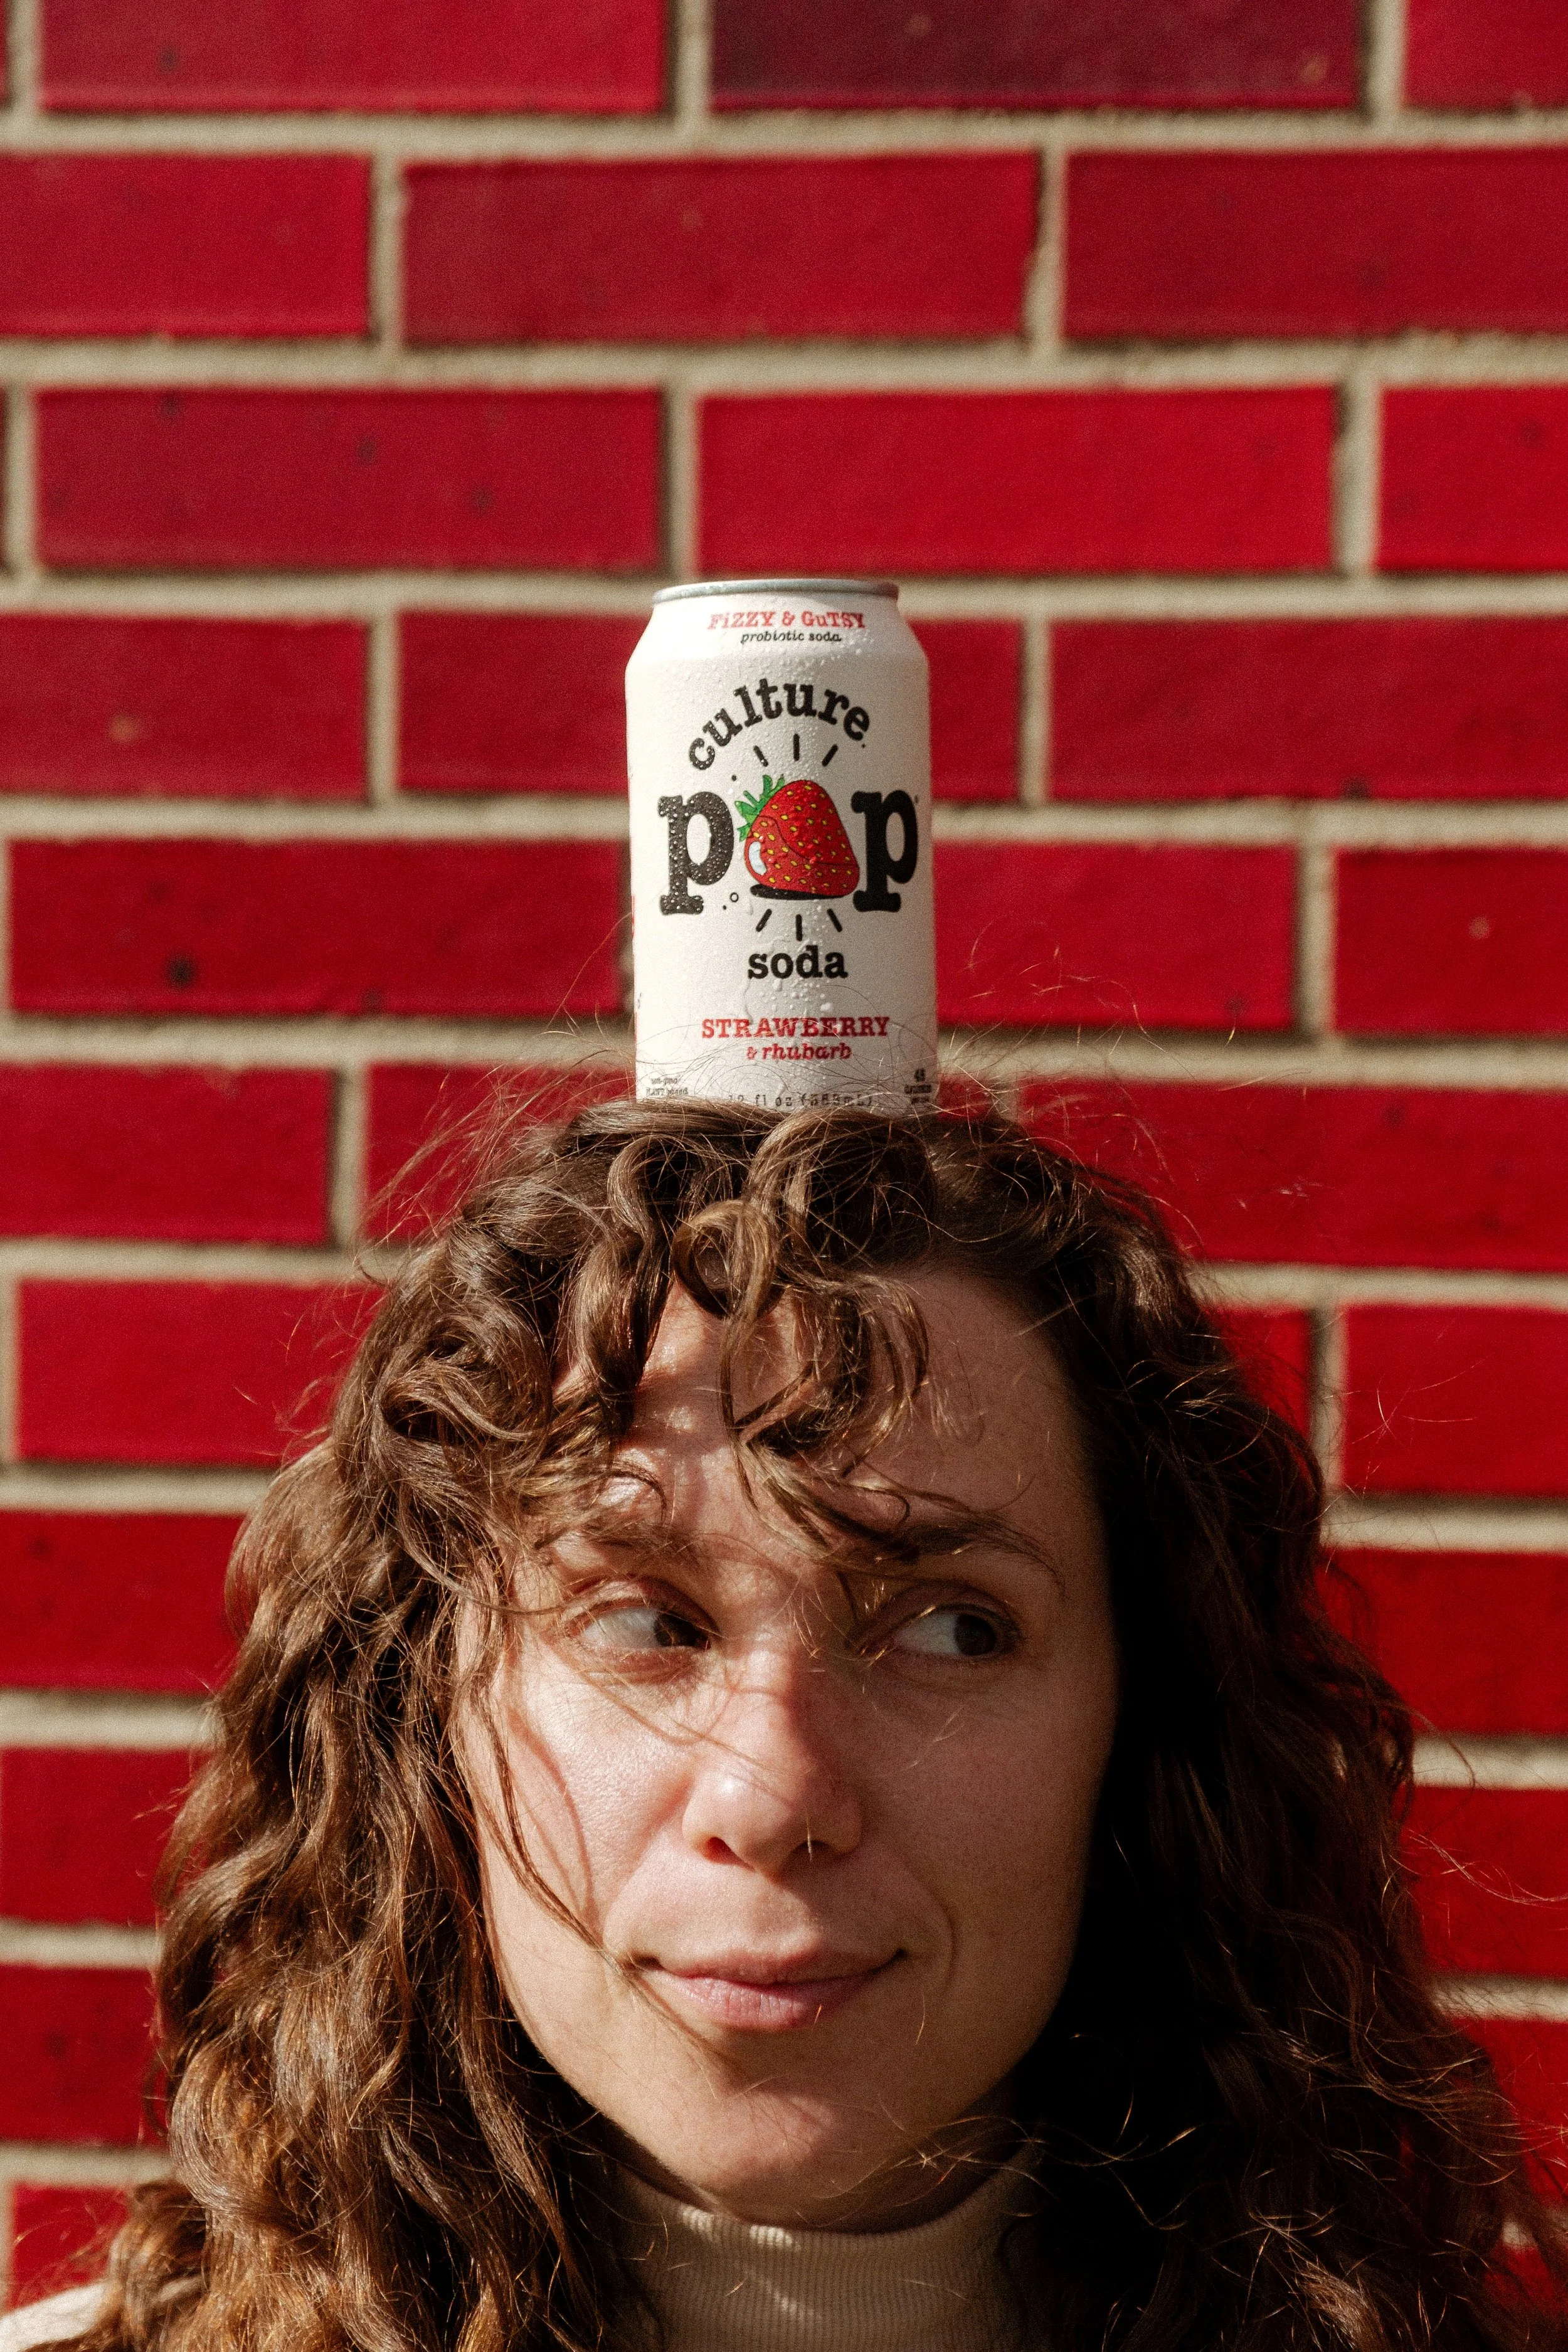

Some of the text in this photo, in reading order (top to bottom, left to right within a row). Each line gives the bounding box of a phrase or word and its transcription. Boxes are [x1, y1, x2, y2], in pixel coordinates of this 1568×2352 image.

[781, 610, 795, 627] &
[740, 630, 842, 644] probiotic soda
[690, 678, 870, 770] culture
[748, 945, 849, 979] soda
[701, 1016, 889, 1039] STRAWBERRY
[747, 1042, 852, 1060] & rhubarb
